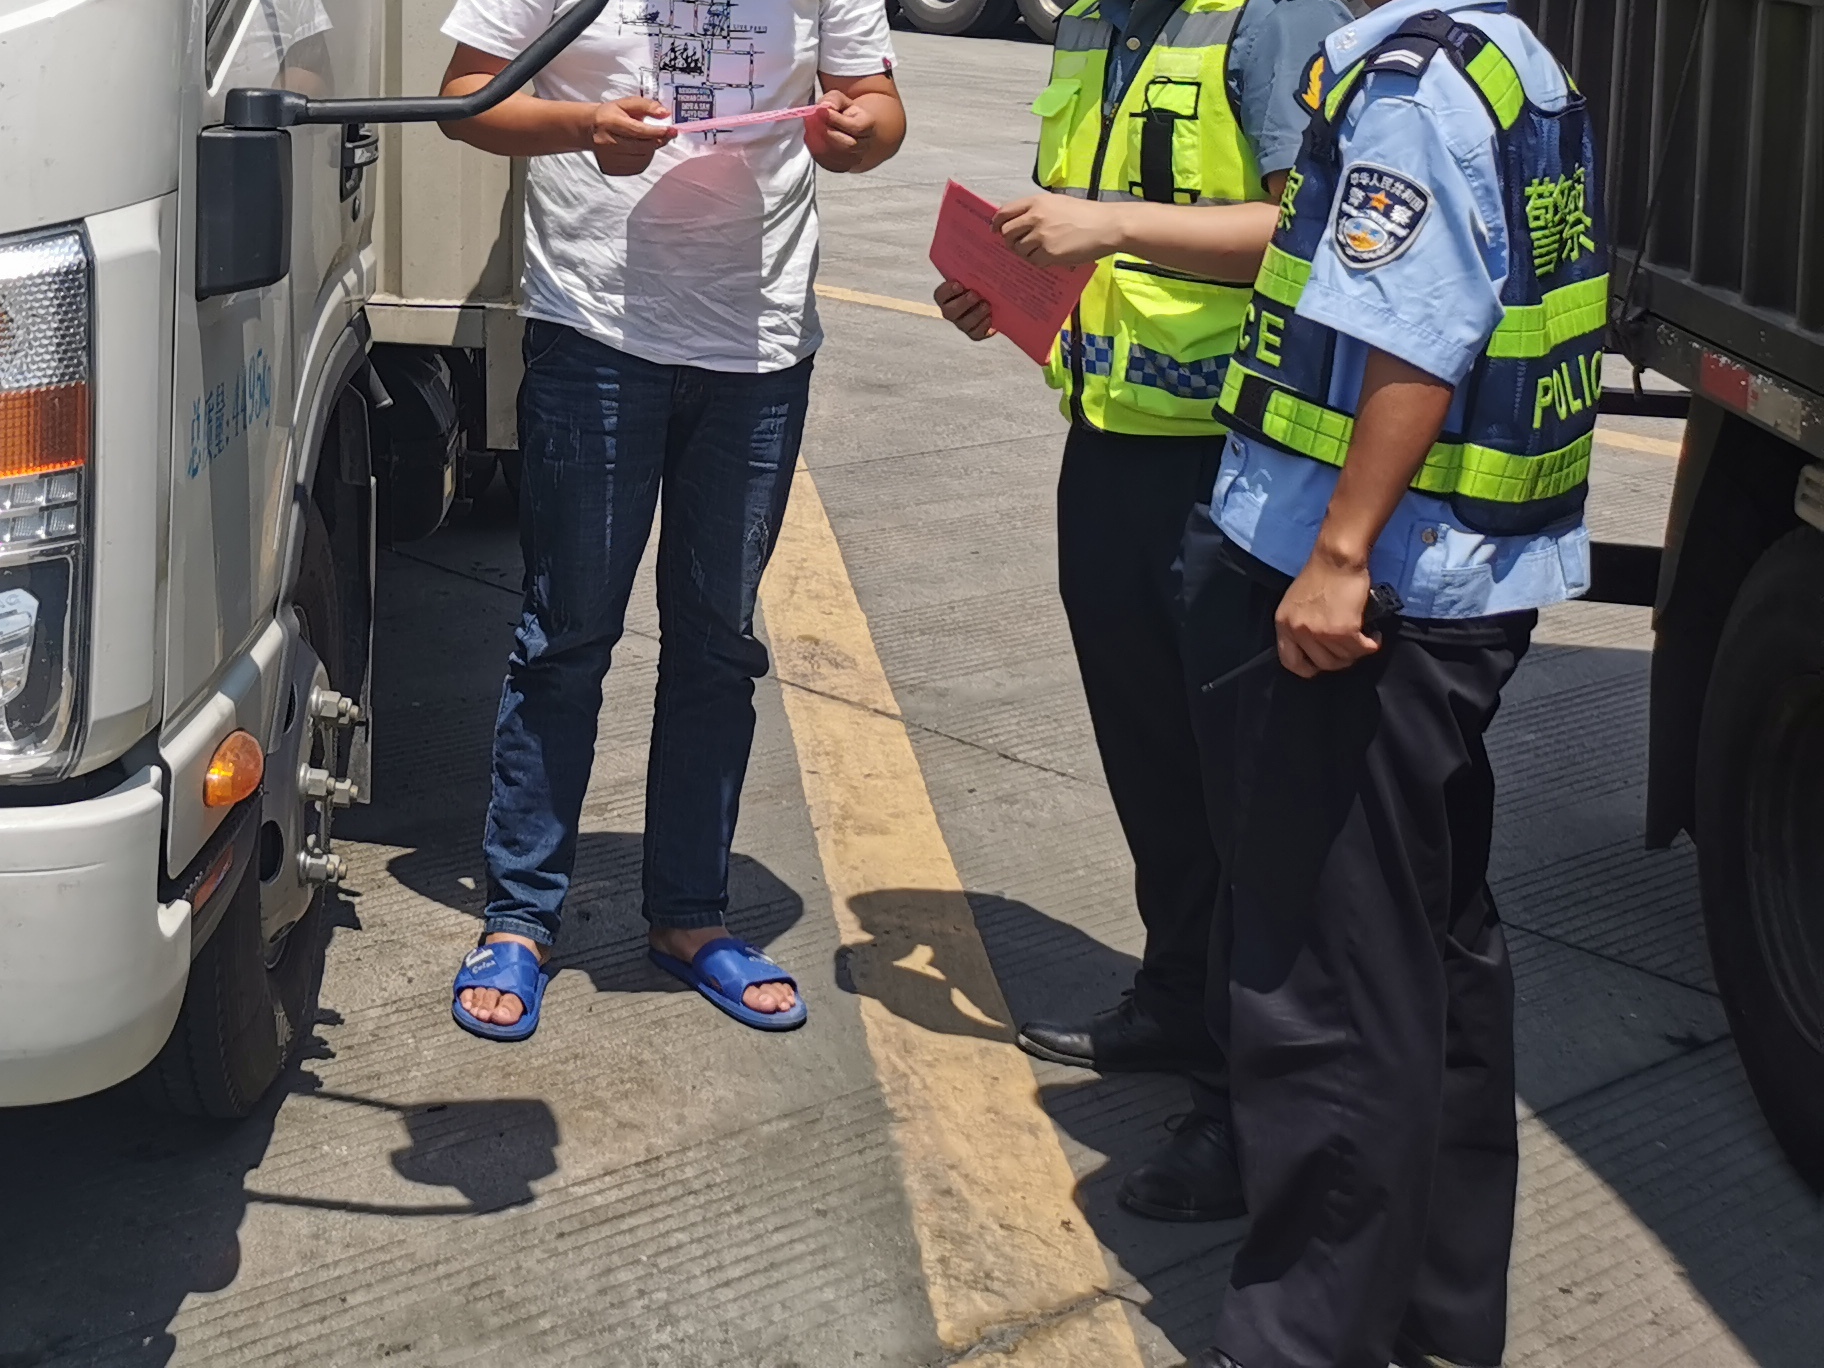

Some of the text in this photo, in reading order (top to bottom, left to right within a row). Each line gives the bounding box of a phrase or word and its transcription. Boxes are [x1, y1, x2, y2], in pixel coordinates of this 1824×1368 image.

[1350, 172, 1425, 212] 中华人民共和国
[1524, 163, 1595, 277] 警察
